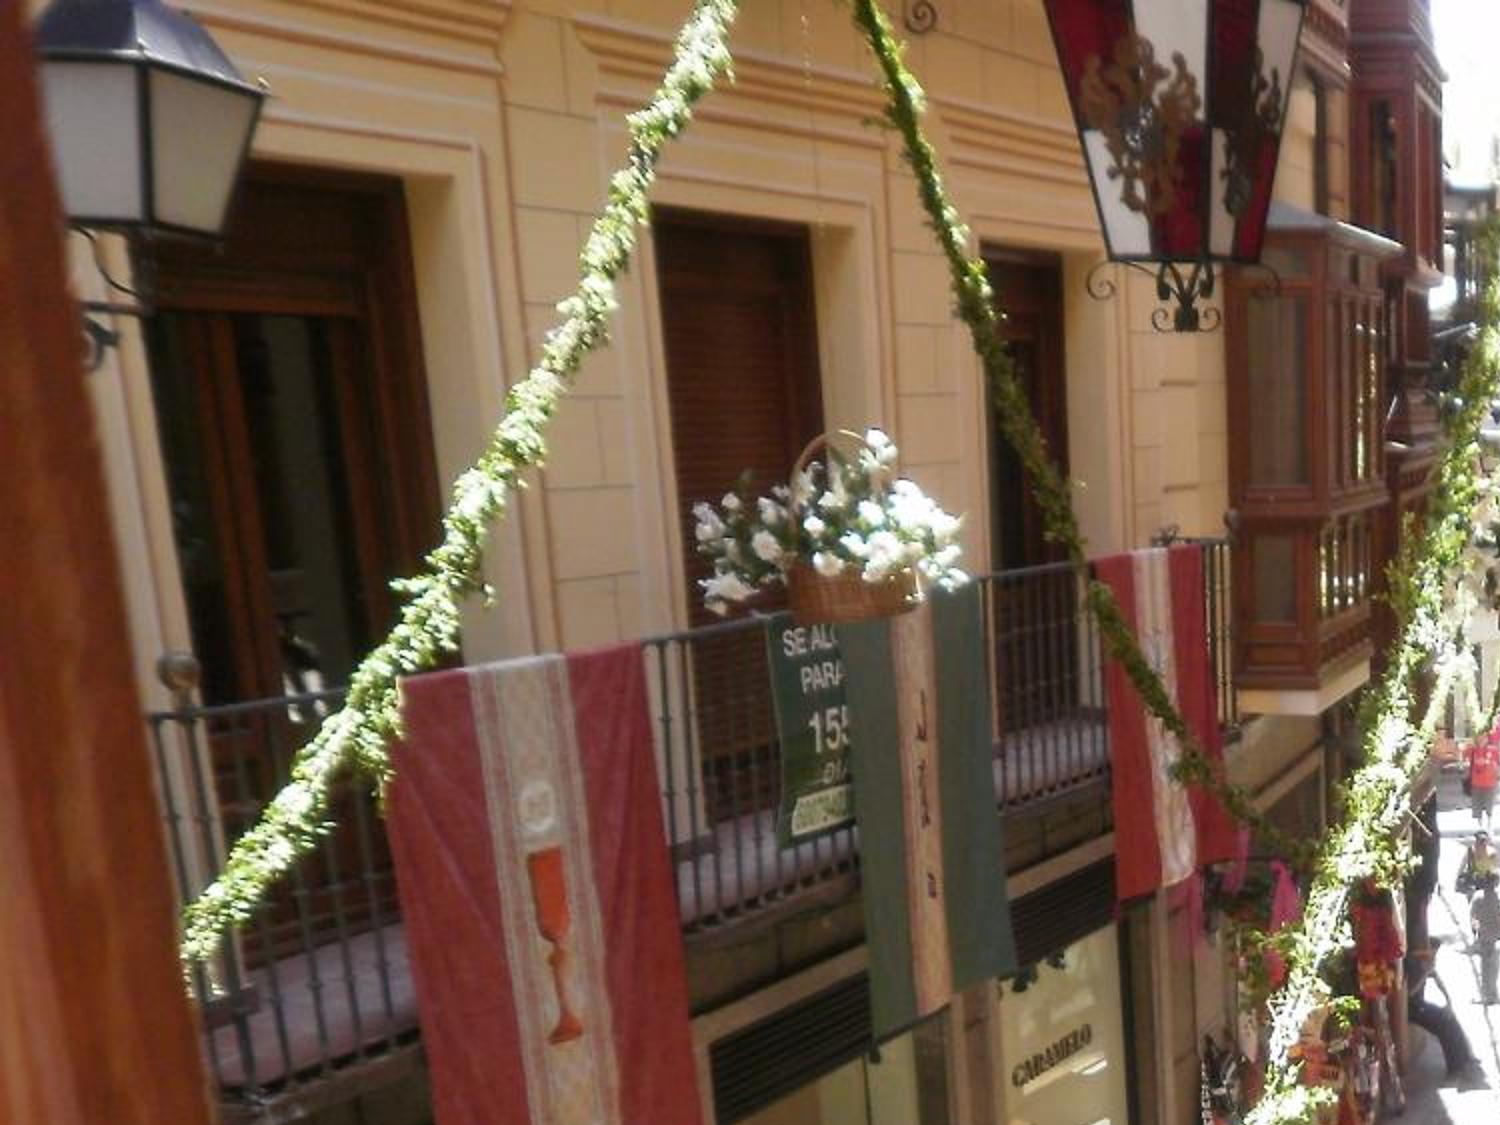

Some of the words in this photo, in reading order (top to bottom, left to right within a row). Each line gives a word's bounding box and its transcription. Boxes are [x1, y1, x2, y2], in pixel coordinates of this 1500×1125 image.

[783, 627, 808, 656] SE
[811, 622, 839, 651] AL
[1012, 1023, 1092, 1088] CARAMELO
